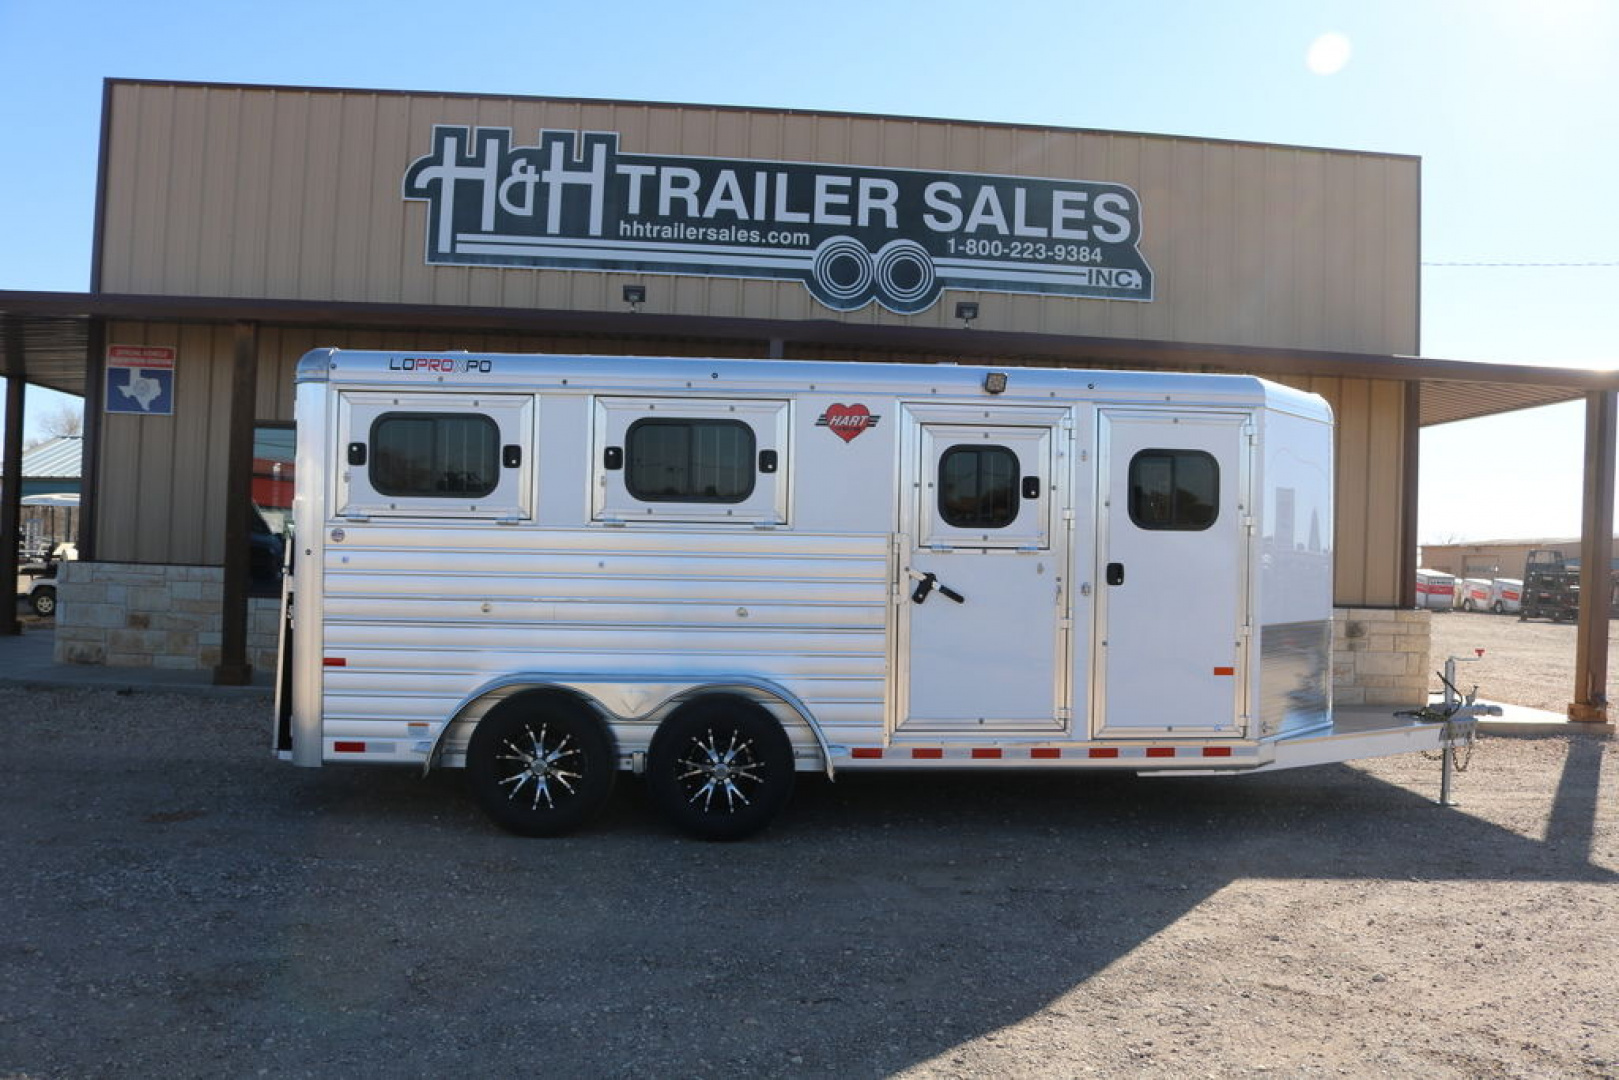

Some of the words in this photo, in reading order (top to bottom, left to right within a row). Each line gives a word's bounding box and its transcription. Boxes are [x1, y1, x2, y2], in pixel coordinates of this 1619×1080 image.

[414, 136, 607, 254] H&H
[615, 163, 899, 229] TRAILER
[923, 181, 1132, 243] SALES
[619, 219, 811, 247] hhtrailersales.com
[946, 237, 1103, 264] 1-800-223-9384
[1087, 268, 1142, 288] INC.
[829, 415, 870, 426] HART
